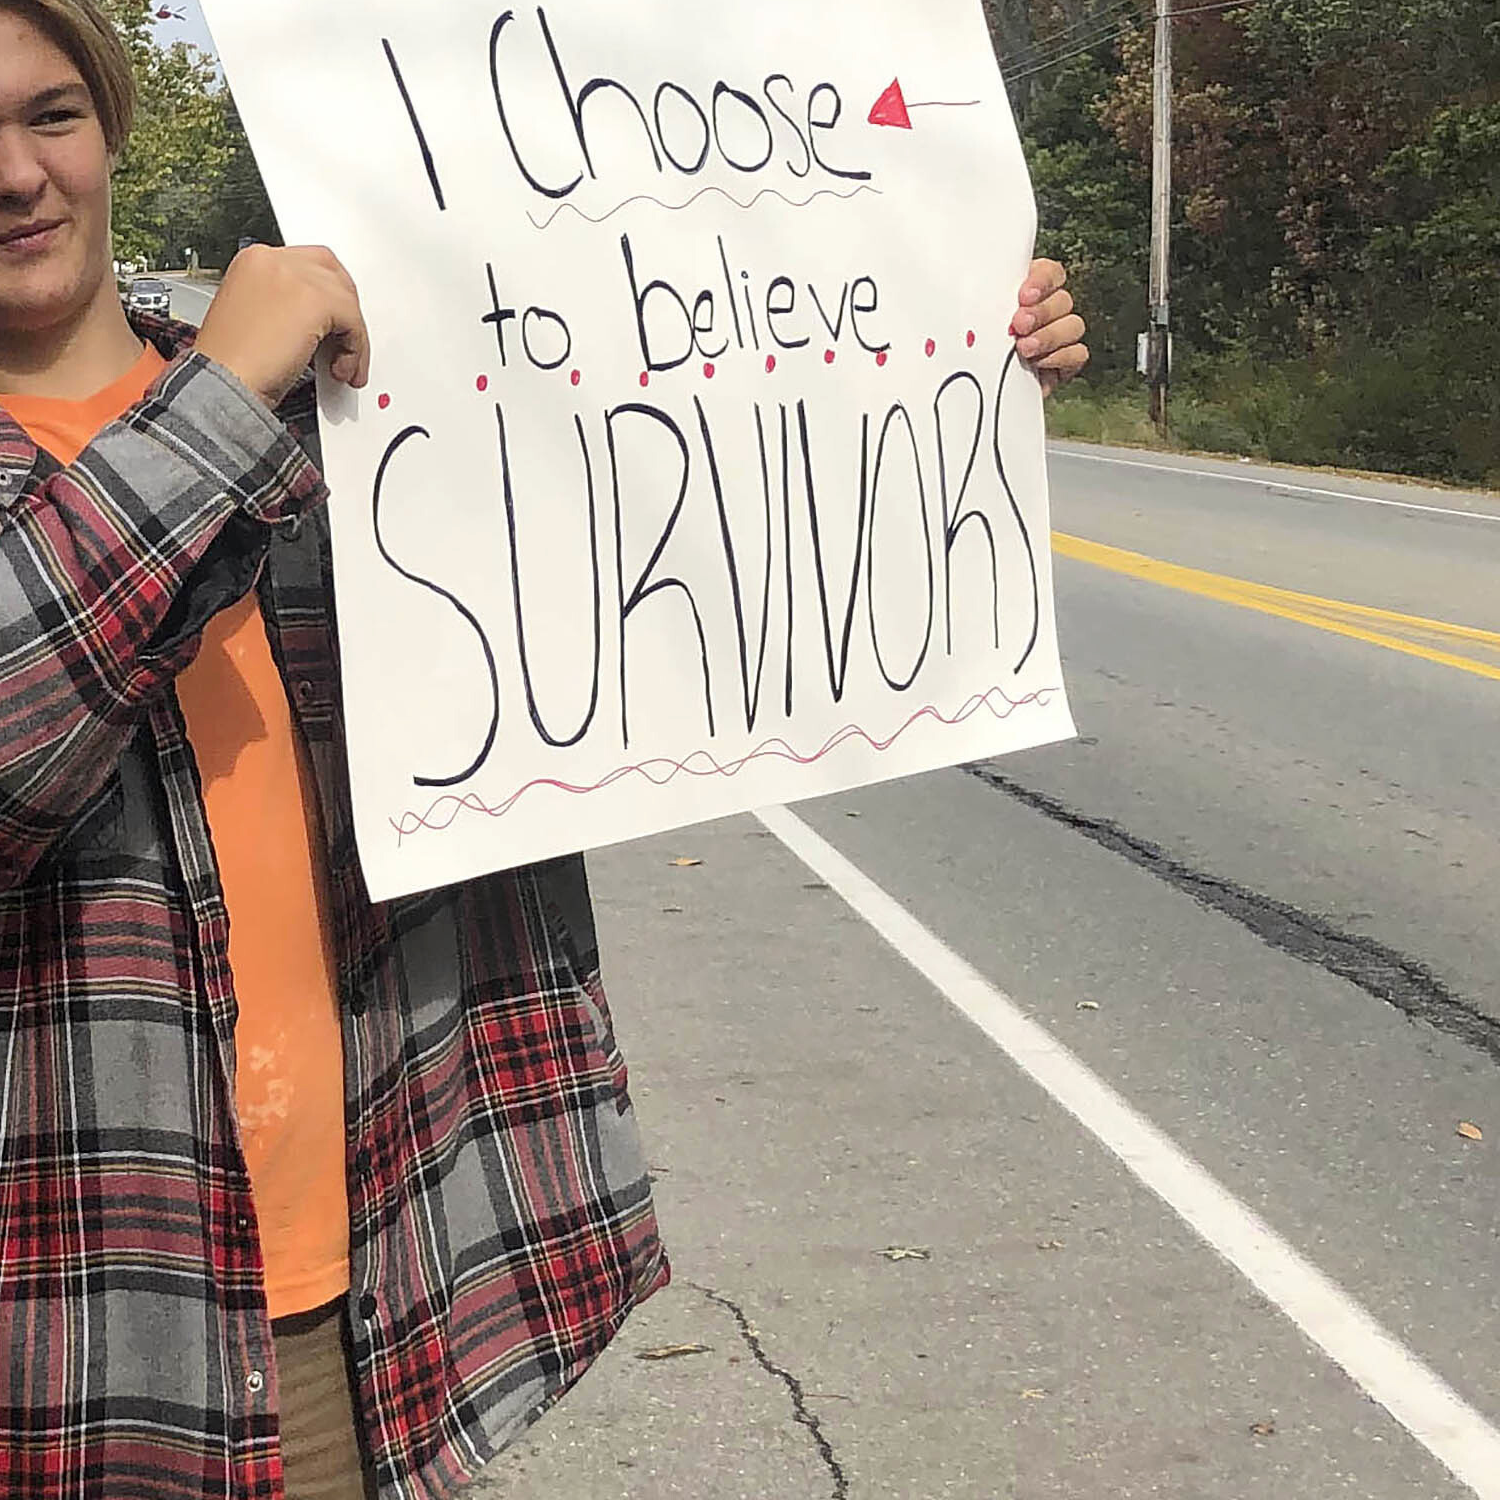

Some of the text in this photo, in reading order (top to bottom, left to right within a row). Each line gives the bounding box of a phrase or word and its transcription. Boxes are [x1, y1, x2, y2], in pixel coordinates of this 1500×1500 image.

[382, 6, 872, 211] I Choose
[481, 233, 891, 373] to believe
[372, 345, 1039, 787] SURVIVORS
